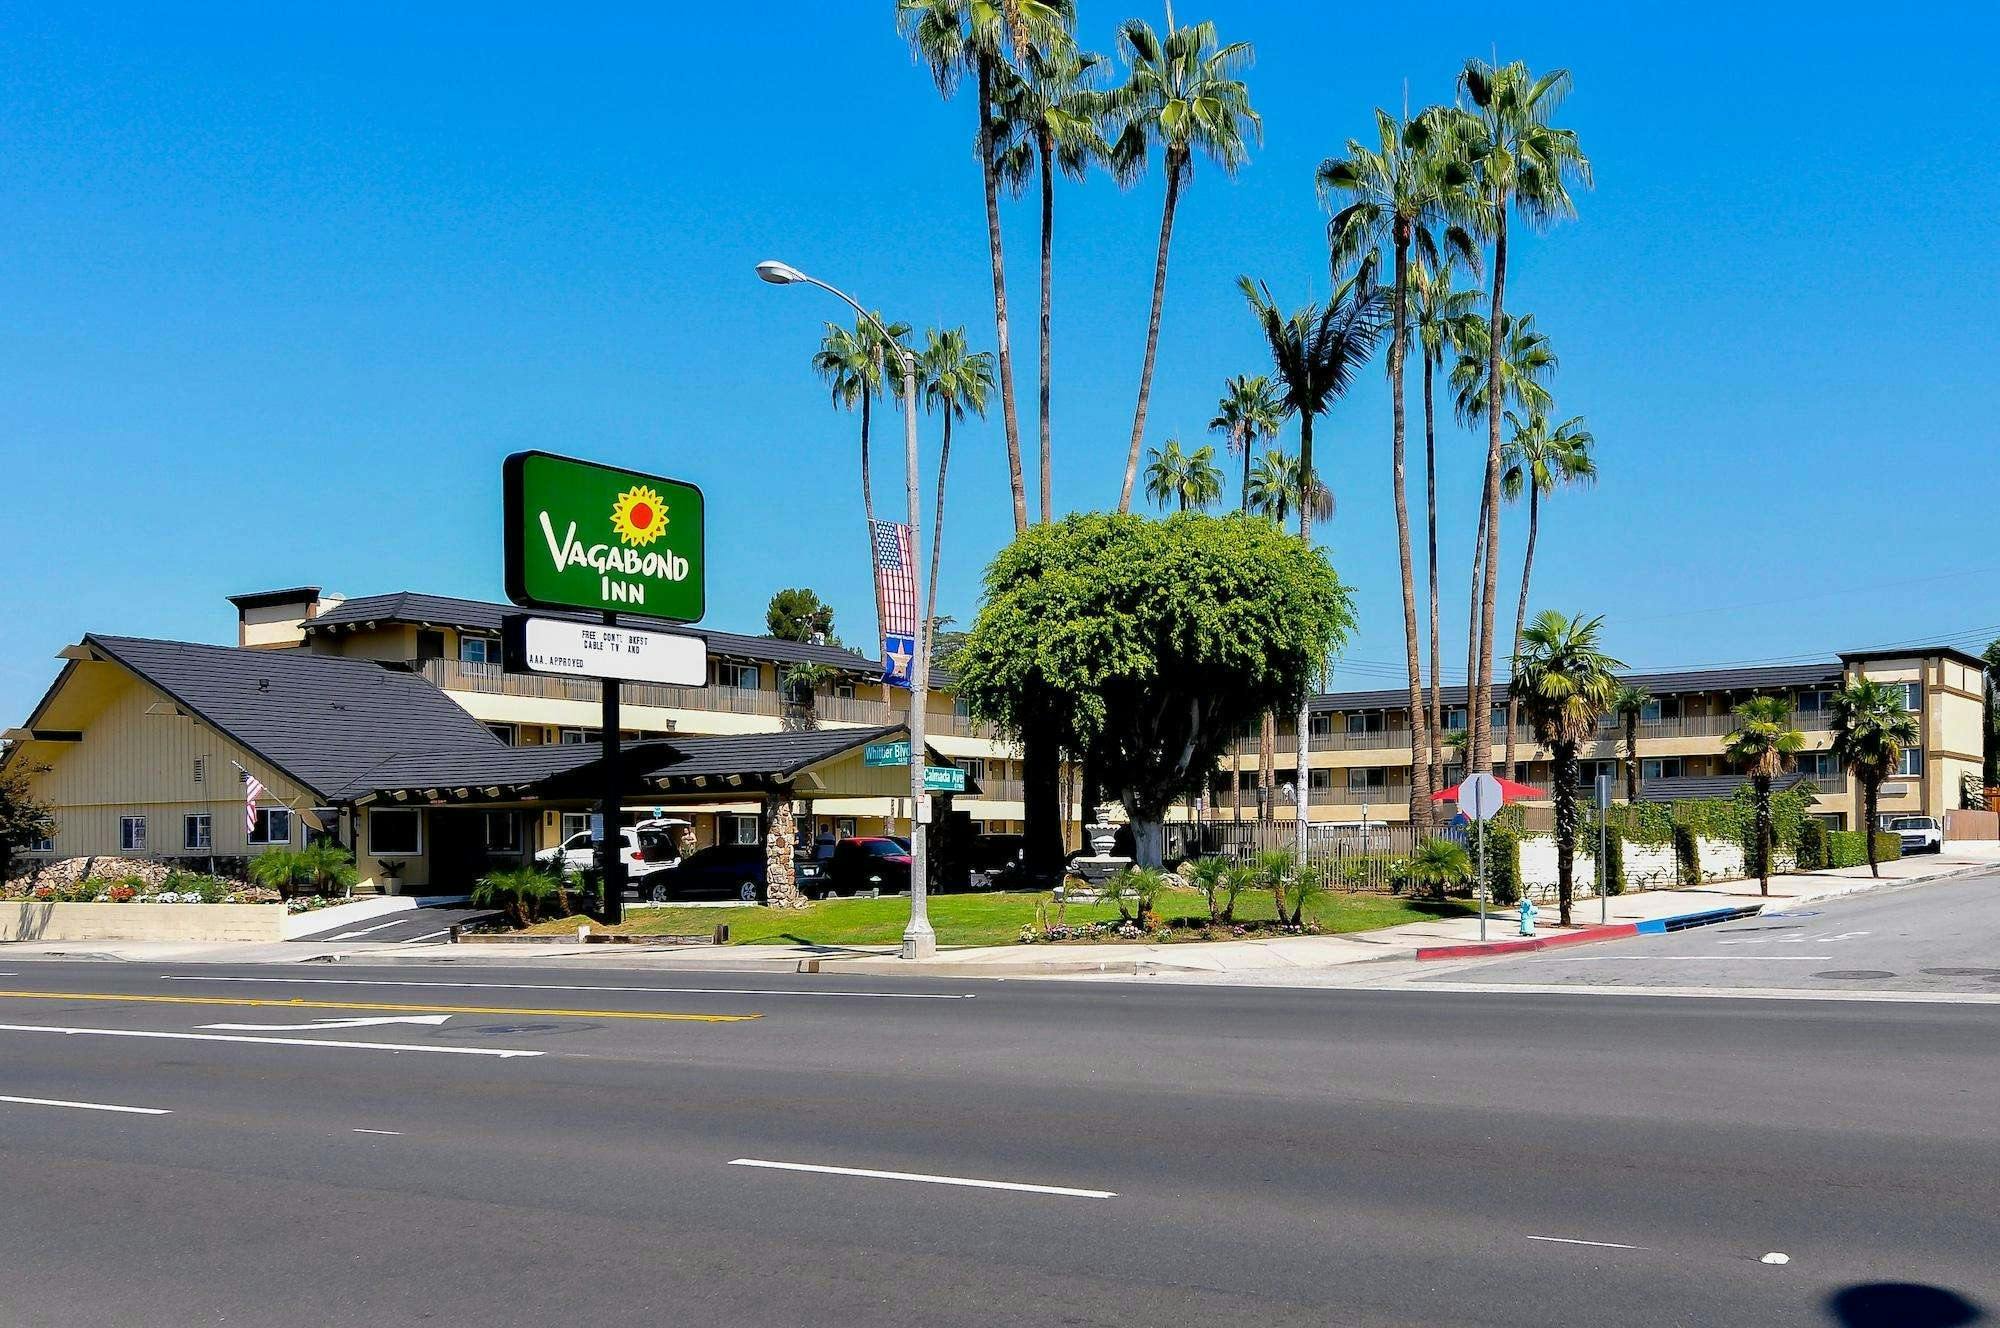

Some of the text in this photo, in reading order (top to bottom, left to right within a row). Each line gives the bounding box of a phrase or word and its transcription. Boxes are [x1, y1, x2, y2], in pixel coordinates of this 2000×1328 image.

[539, 510, 689, 582] VAGABOND
[601, 576, 645, 605] INN
[581, 630, 596, 640] FREE
[583, 640, 640, 654] CABLE TV AND
[865, 747, 893, 760] Whittier
[894, 744, 910, 758] Blvd
[951, 770, 964, 784] Ave
